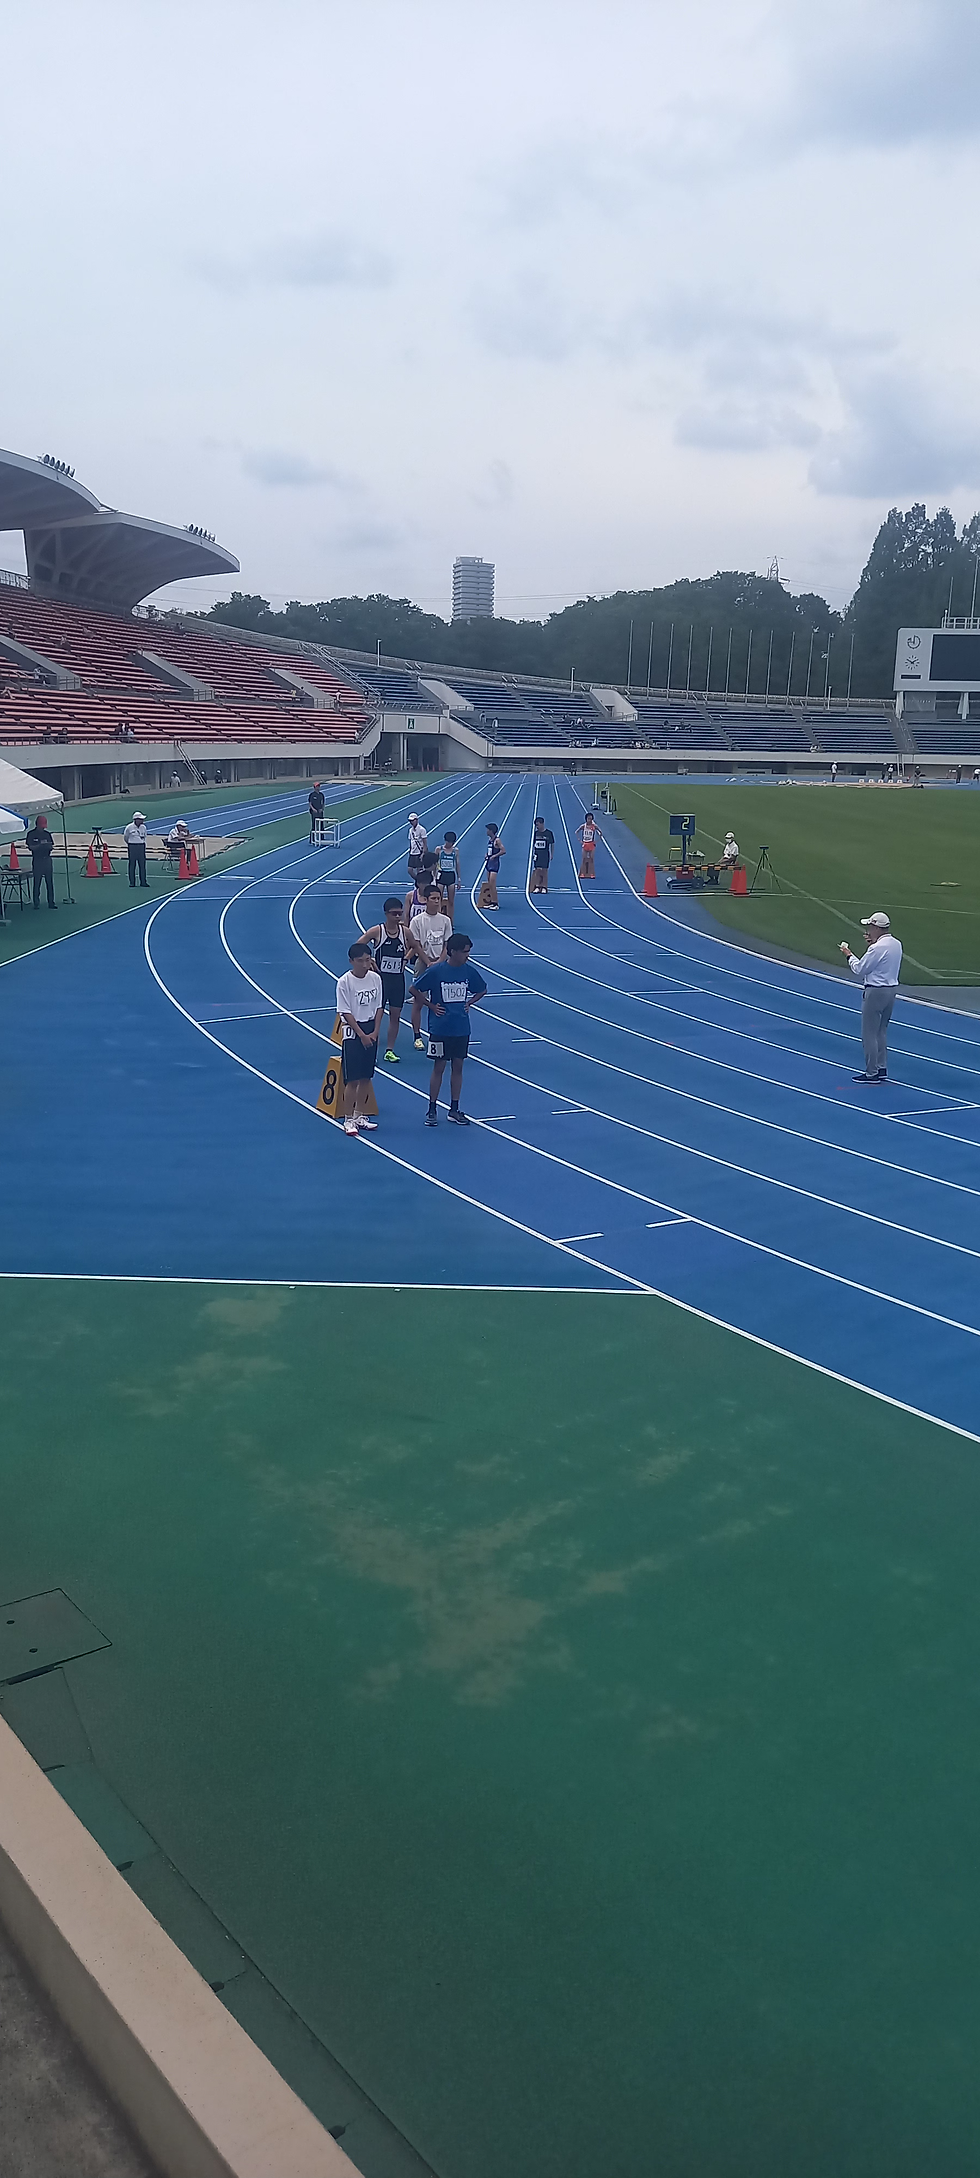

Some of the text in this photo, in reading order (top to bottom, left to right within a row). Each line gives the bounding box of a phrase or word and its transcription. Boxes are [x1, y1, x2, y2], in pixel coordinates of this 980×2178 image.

[681, 816, 690, 830] 2
[482, 888, 492, 904] 3
[430, 1044, 436, 1055] 8
[322, 1069, 337, 1106] 8
